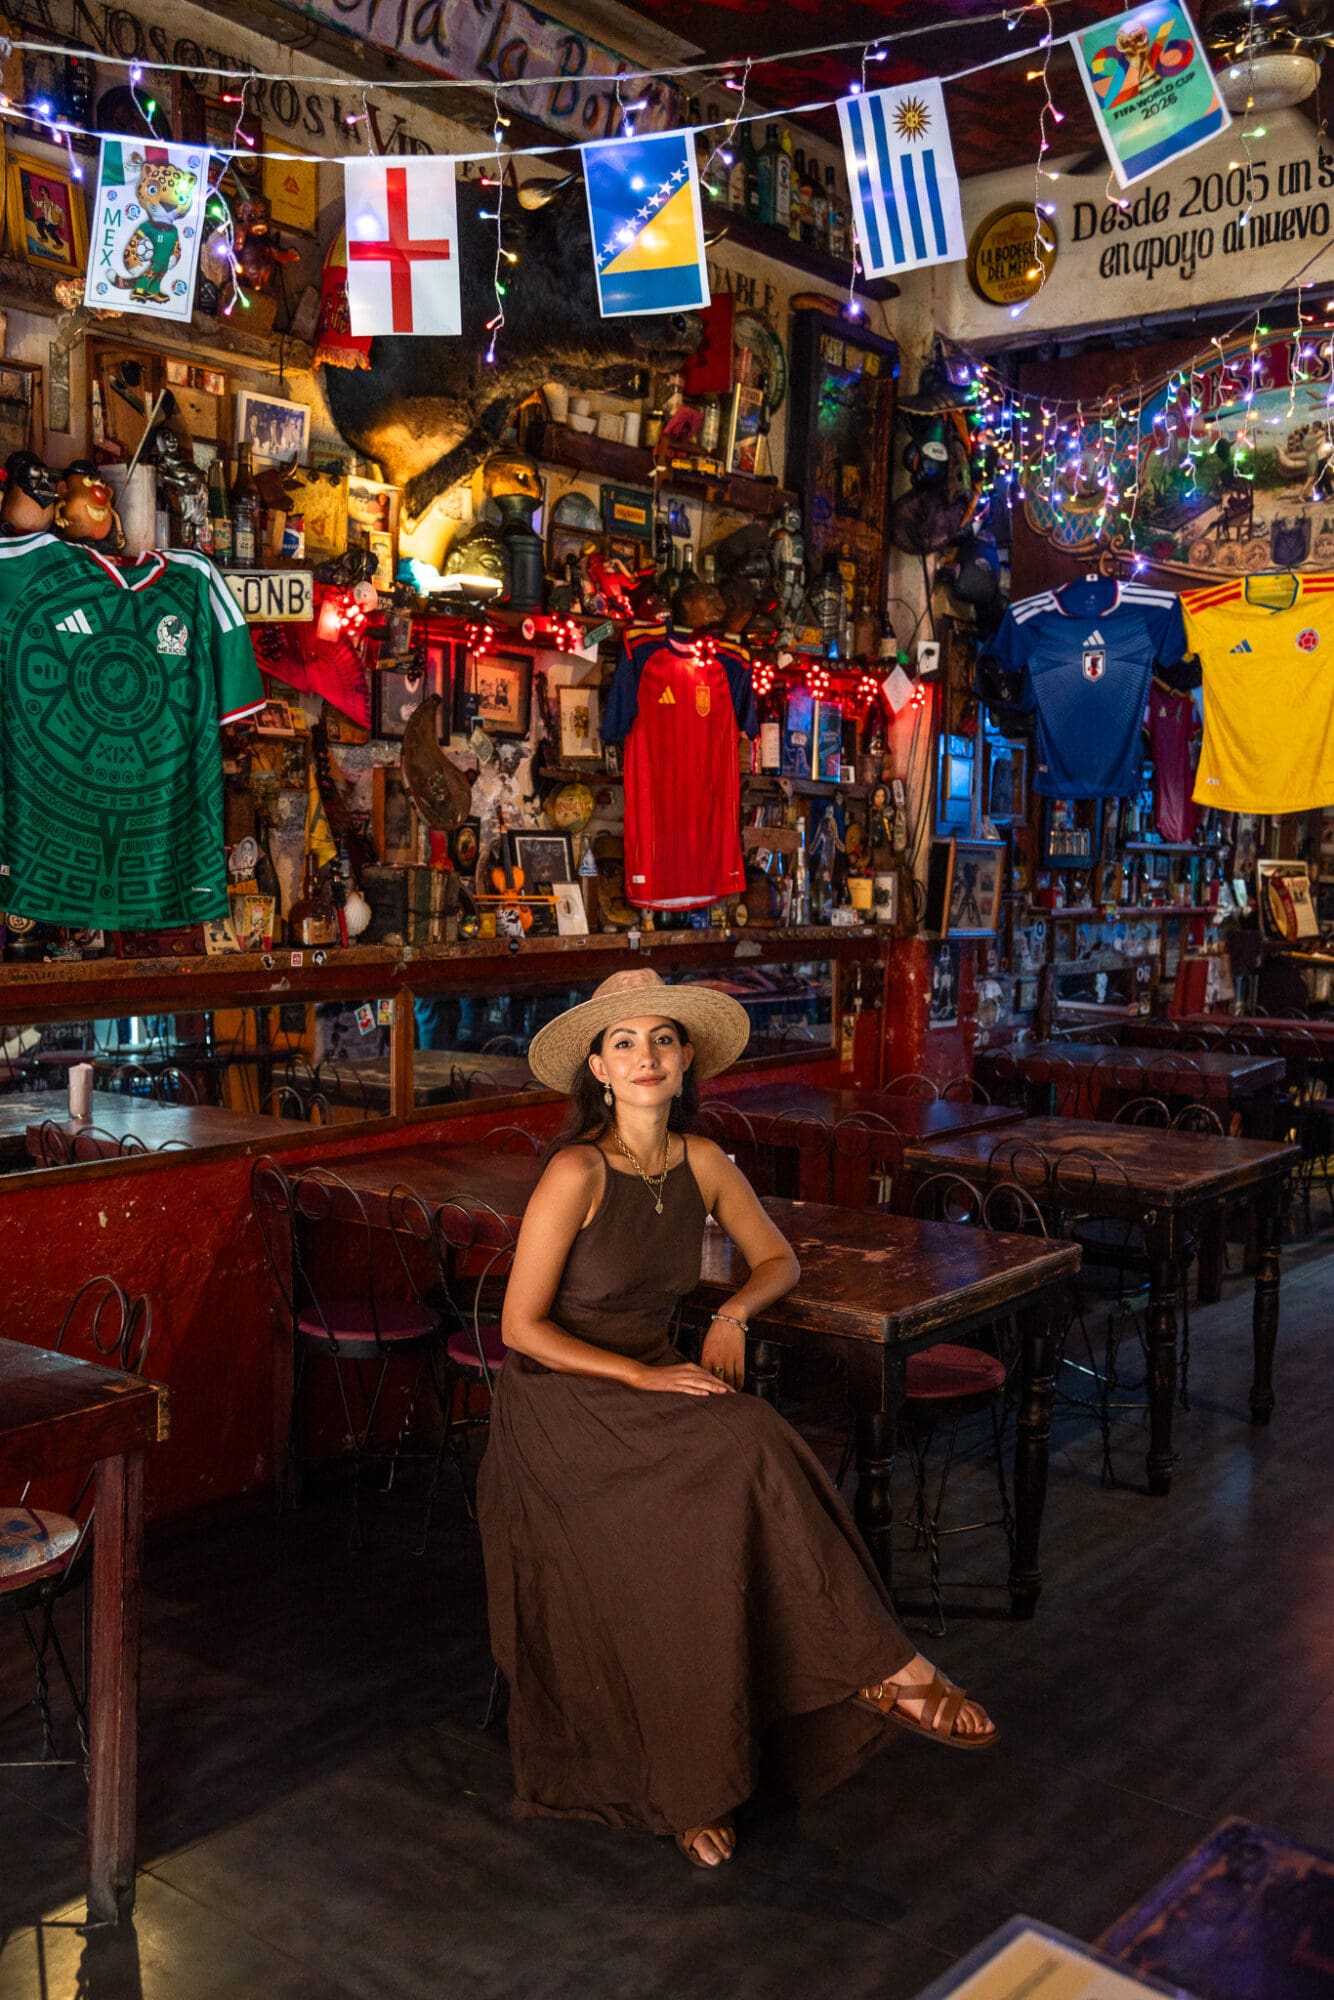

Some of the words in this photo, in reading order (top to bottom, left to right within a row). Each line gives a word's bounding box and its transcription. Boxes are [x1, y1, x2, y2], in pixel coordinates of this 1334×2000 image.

[1113, 105, 1136, 120] FIFA
[1135, 82, 1174, 110] WORLD
[1174, 70, 1196, 88] CUP
[1141, 93, 1178, 121] 2026
[1071, 186, 1170, 242] Desde
[1178, 160, 1269, 219] 2005
[1279, 159, 1311, 197] un
[100, 207, 122, 267] MEX
[1099, 240, 1130, 279] en
[1133, 225, 1214, 281] apoyo
[1249, 201, 1330, 249] nuevo
